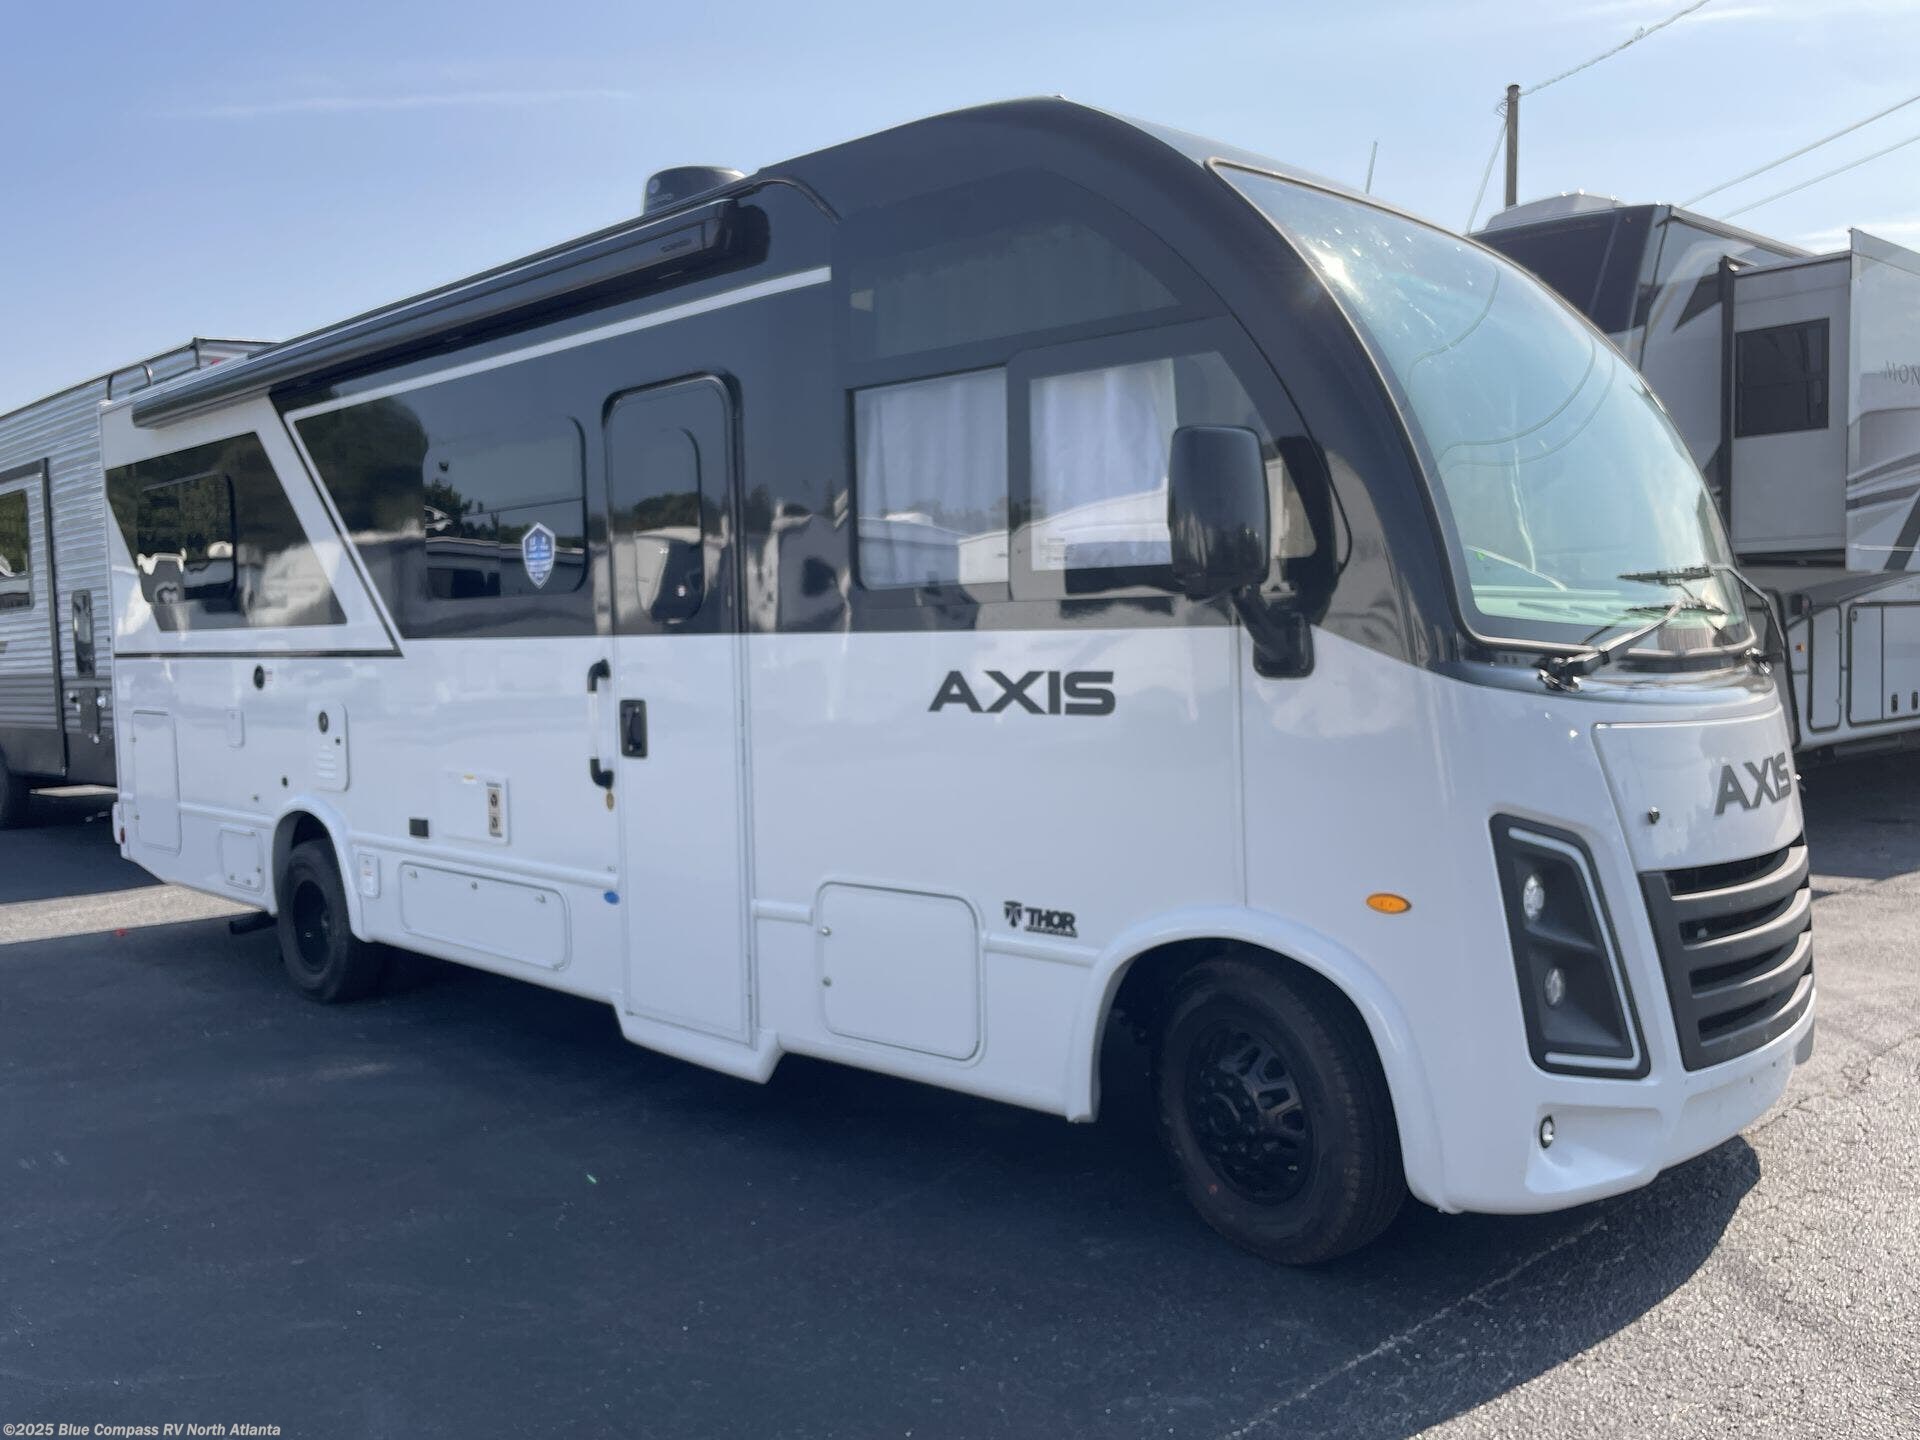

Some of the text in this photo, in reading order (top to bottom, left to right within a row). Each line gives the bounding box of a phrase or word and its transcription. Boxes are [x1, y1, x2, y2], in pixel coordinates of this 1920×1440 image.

[928, 670, 1116, 716] AXIS
[1714, 752, 1792, 816] AXIS
[1025, 907, 1076, 931] THOR
